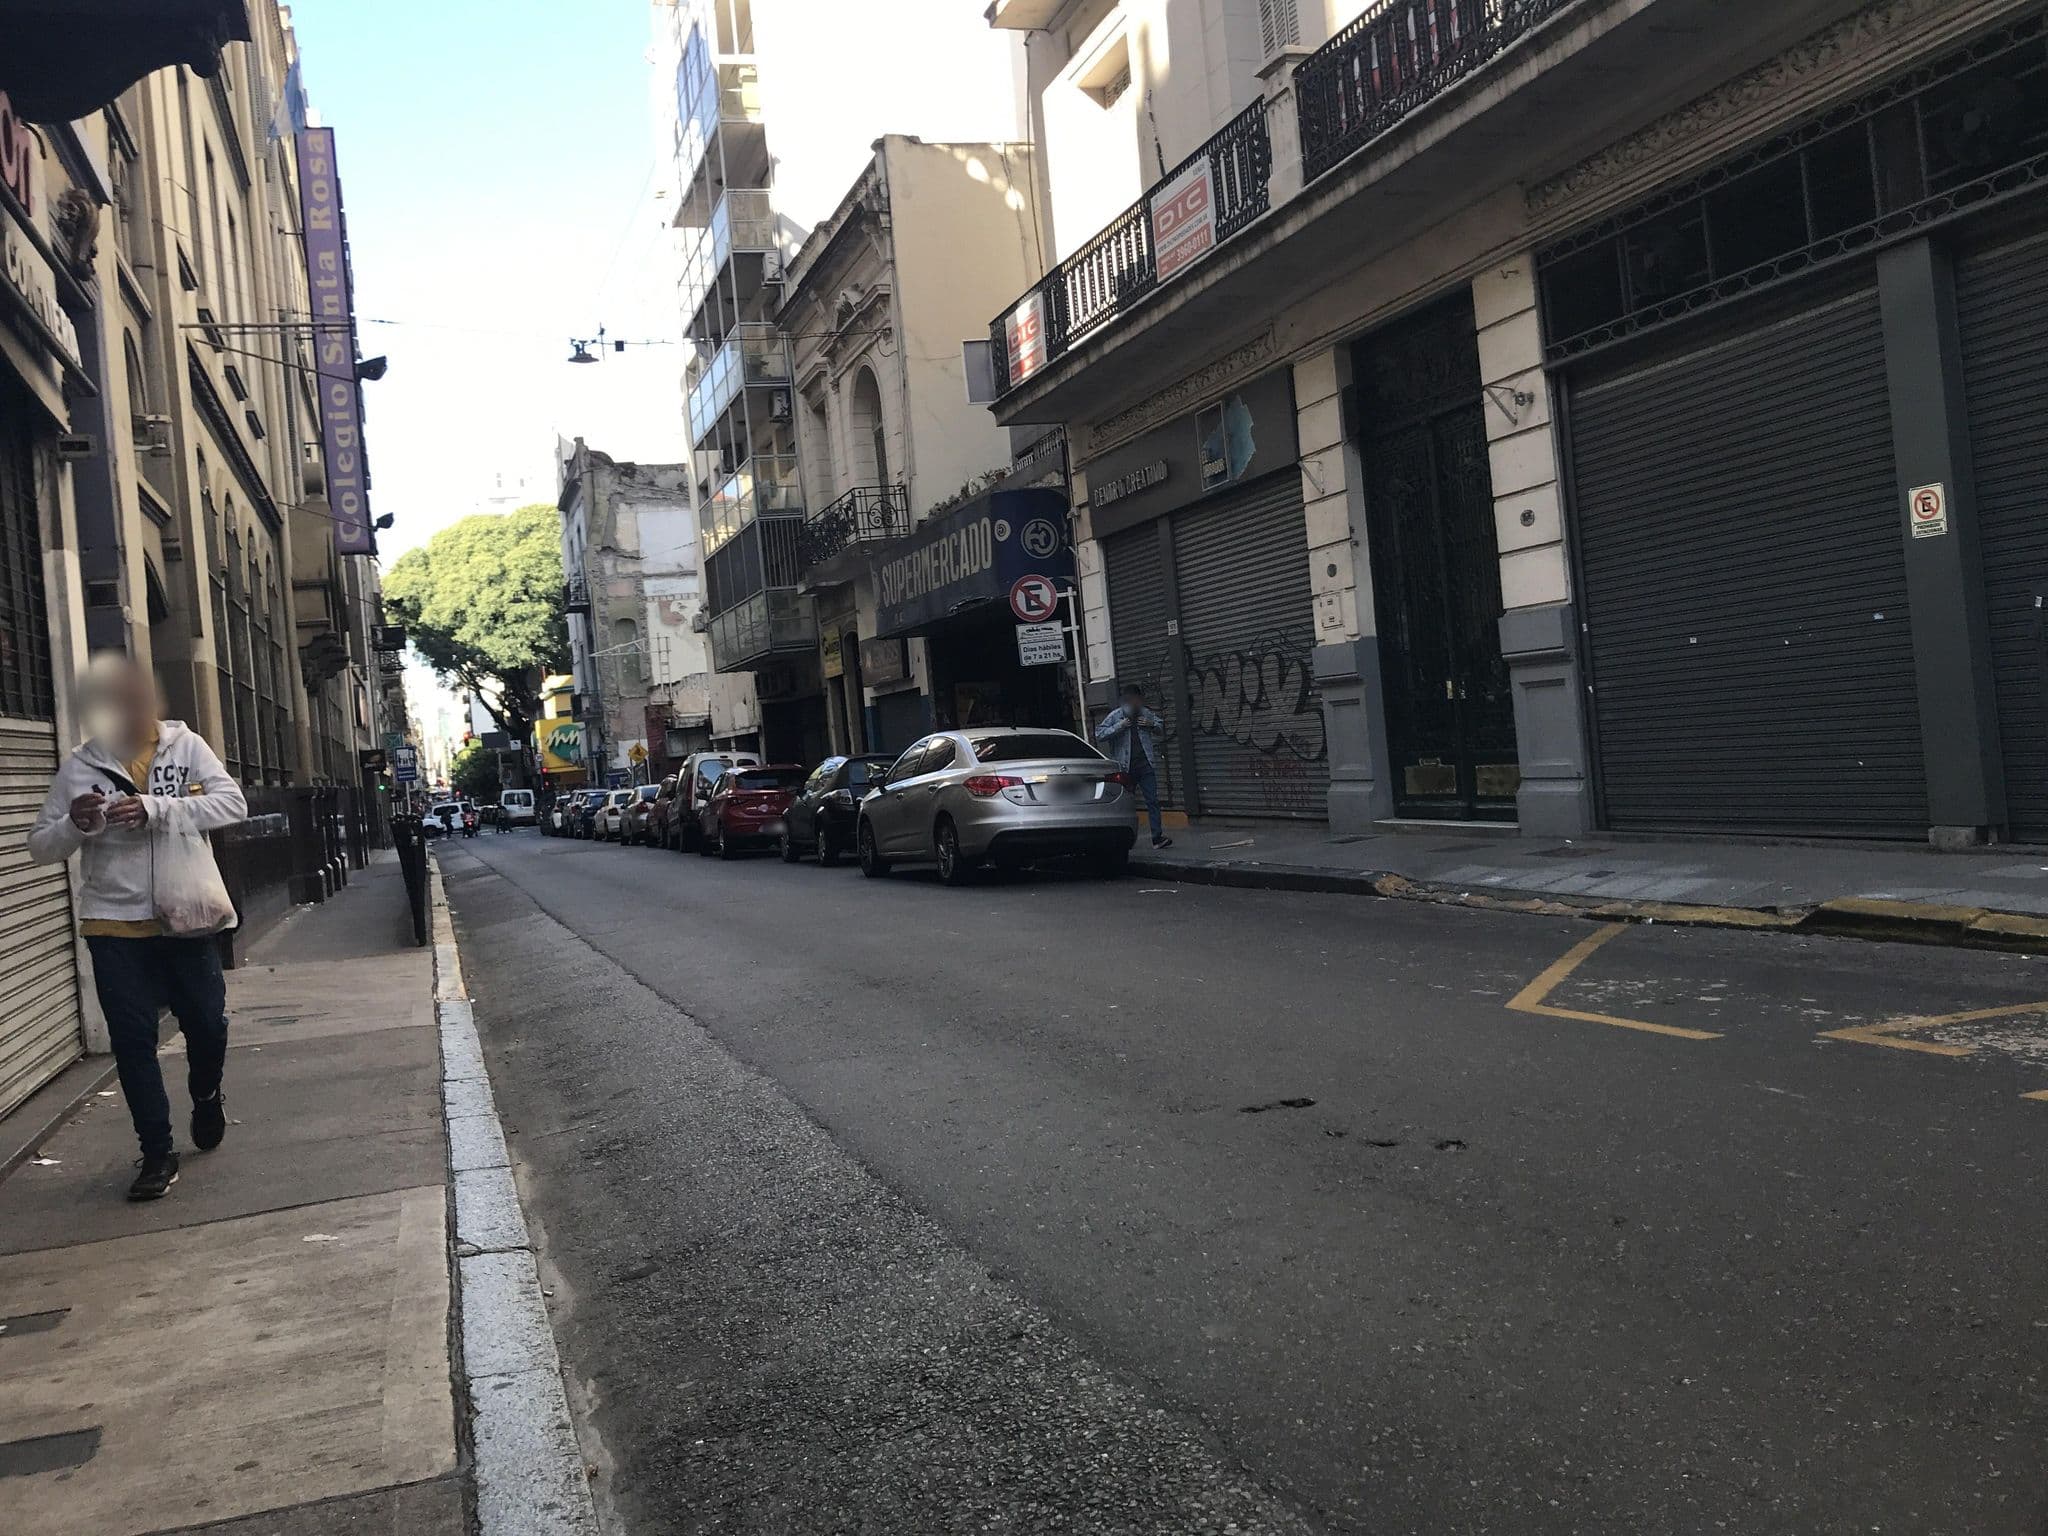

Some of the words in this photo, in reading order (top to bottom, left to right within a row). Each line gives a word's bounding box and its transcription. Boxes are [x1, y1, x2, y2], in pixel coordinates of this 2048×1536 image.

[307, 133, 333, 230] Rosa
[1159, 186, 1202, 233] DIC
[316, 251, 344, 365] Santa
[328, 383, 362, 543] Colegio
[882, 517, 992, 608] SUPERMERCADO
